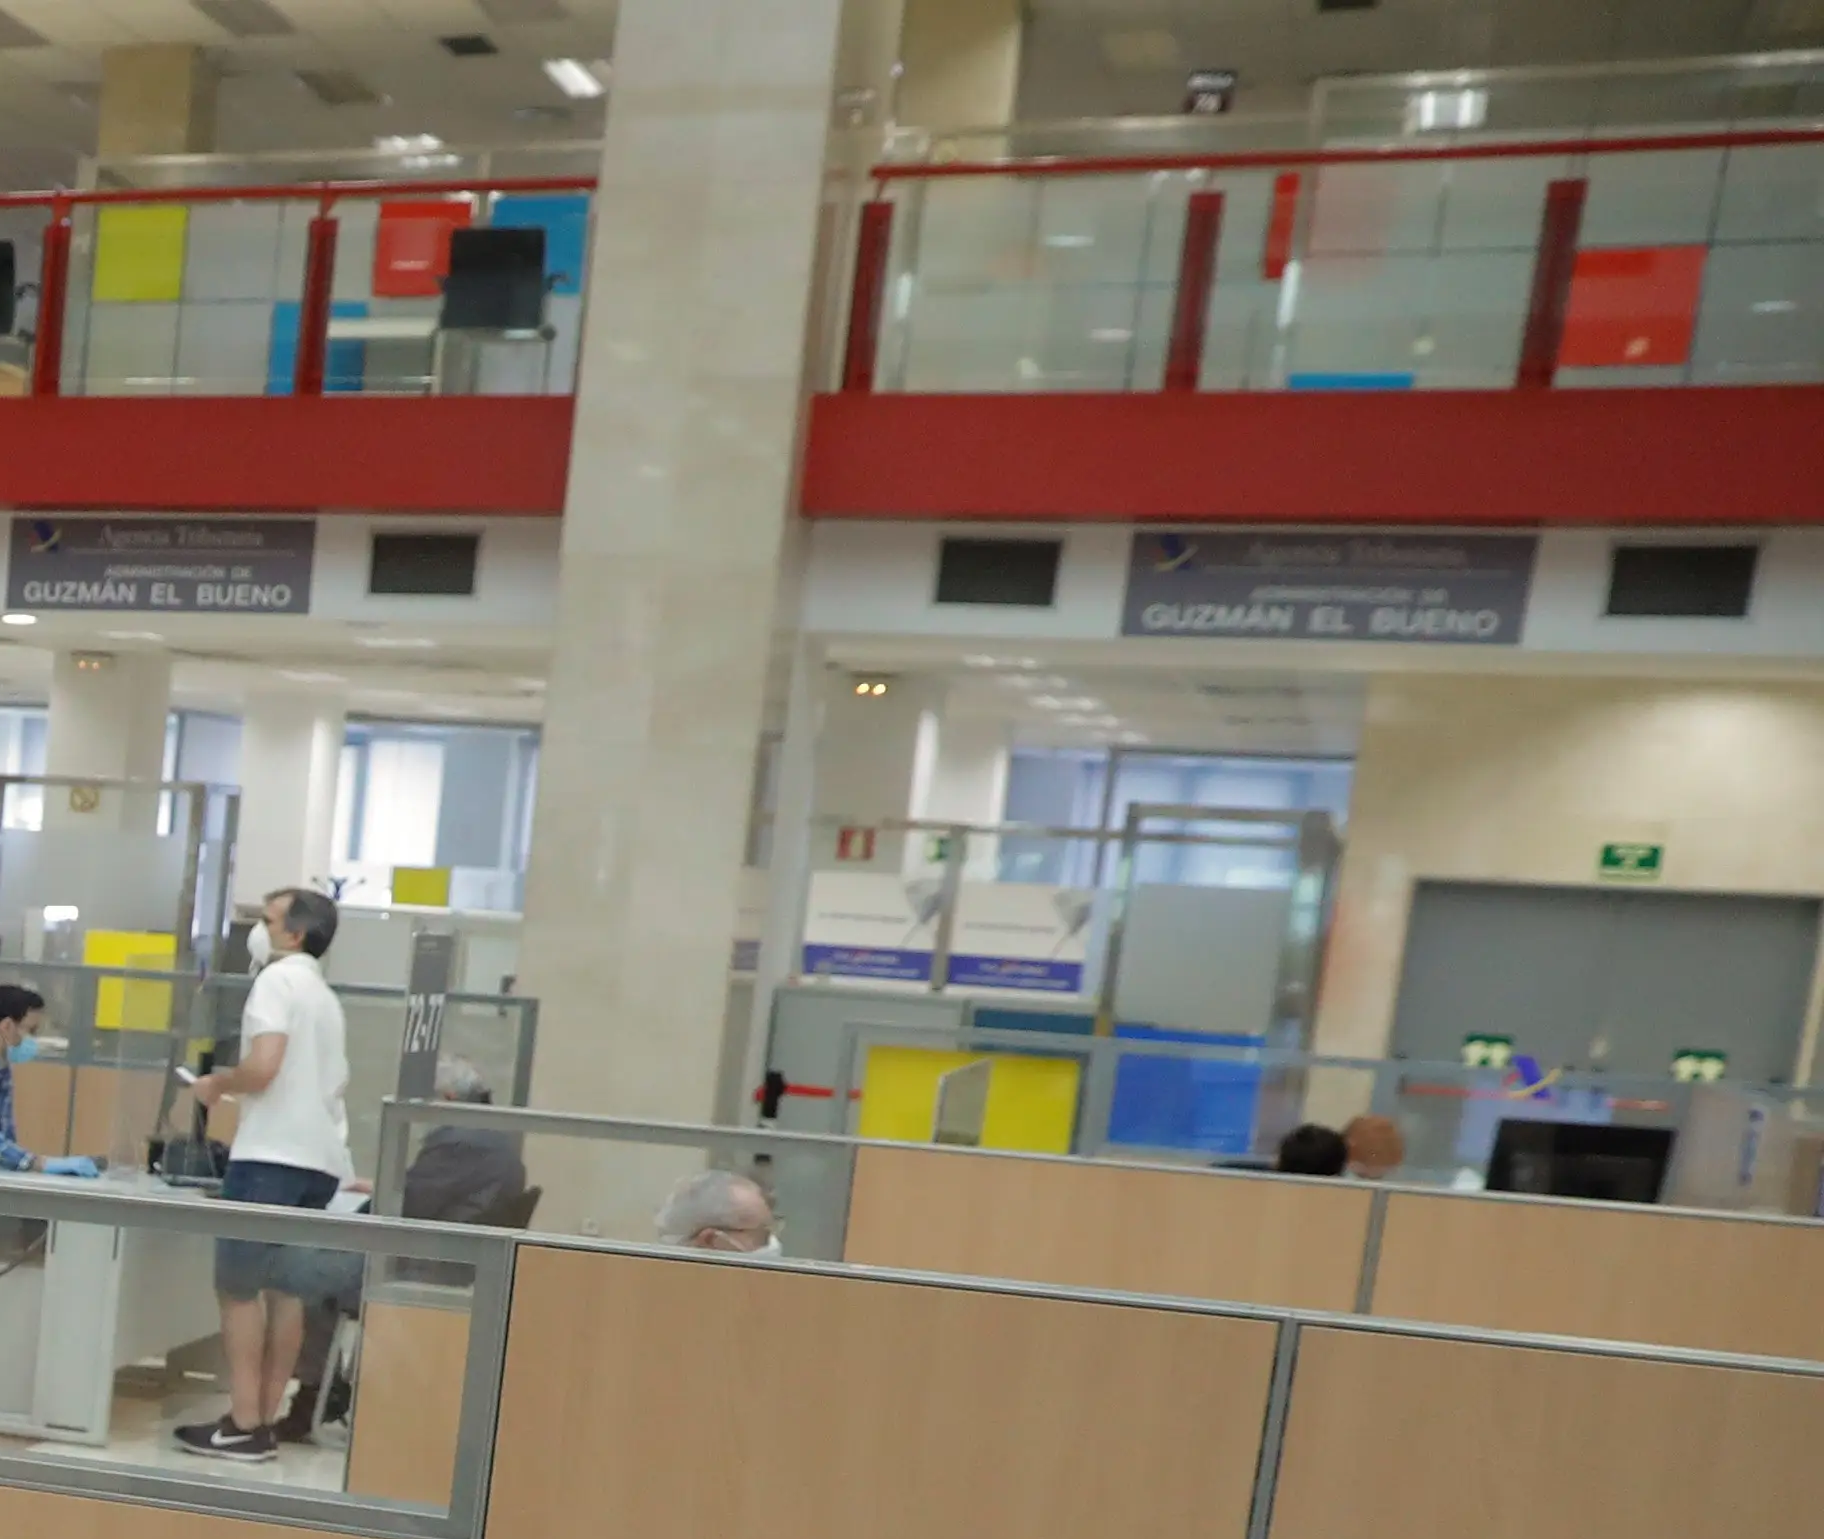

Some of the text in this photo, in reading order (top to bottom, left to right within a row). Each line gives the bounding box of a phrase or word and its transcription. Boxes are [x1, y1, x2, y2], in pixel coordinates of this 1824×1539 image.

[22, 577, 293, 608] GUZMÁN EL BUENO
[1306, 604, 1355, 635] EL
[1368, 606, 1502, 638] BUENO
